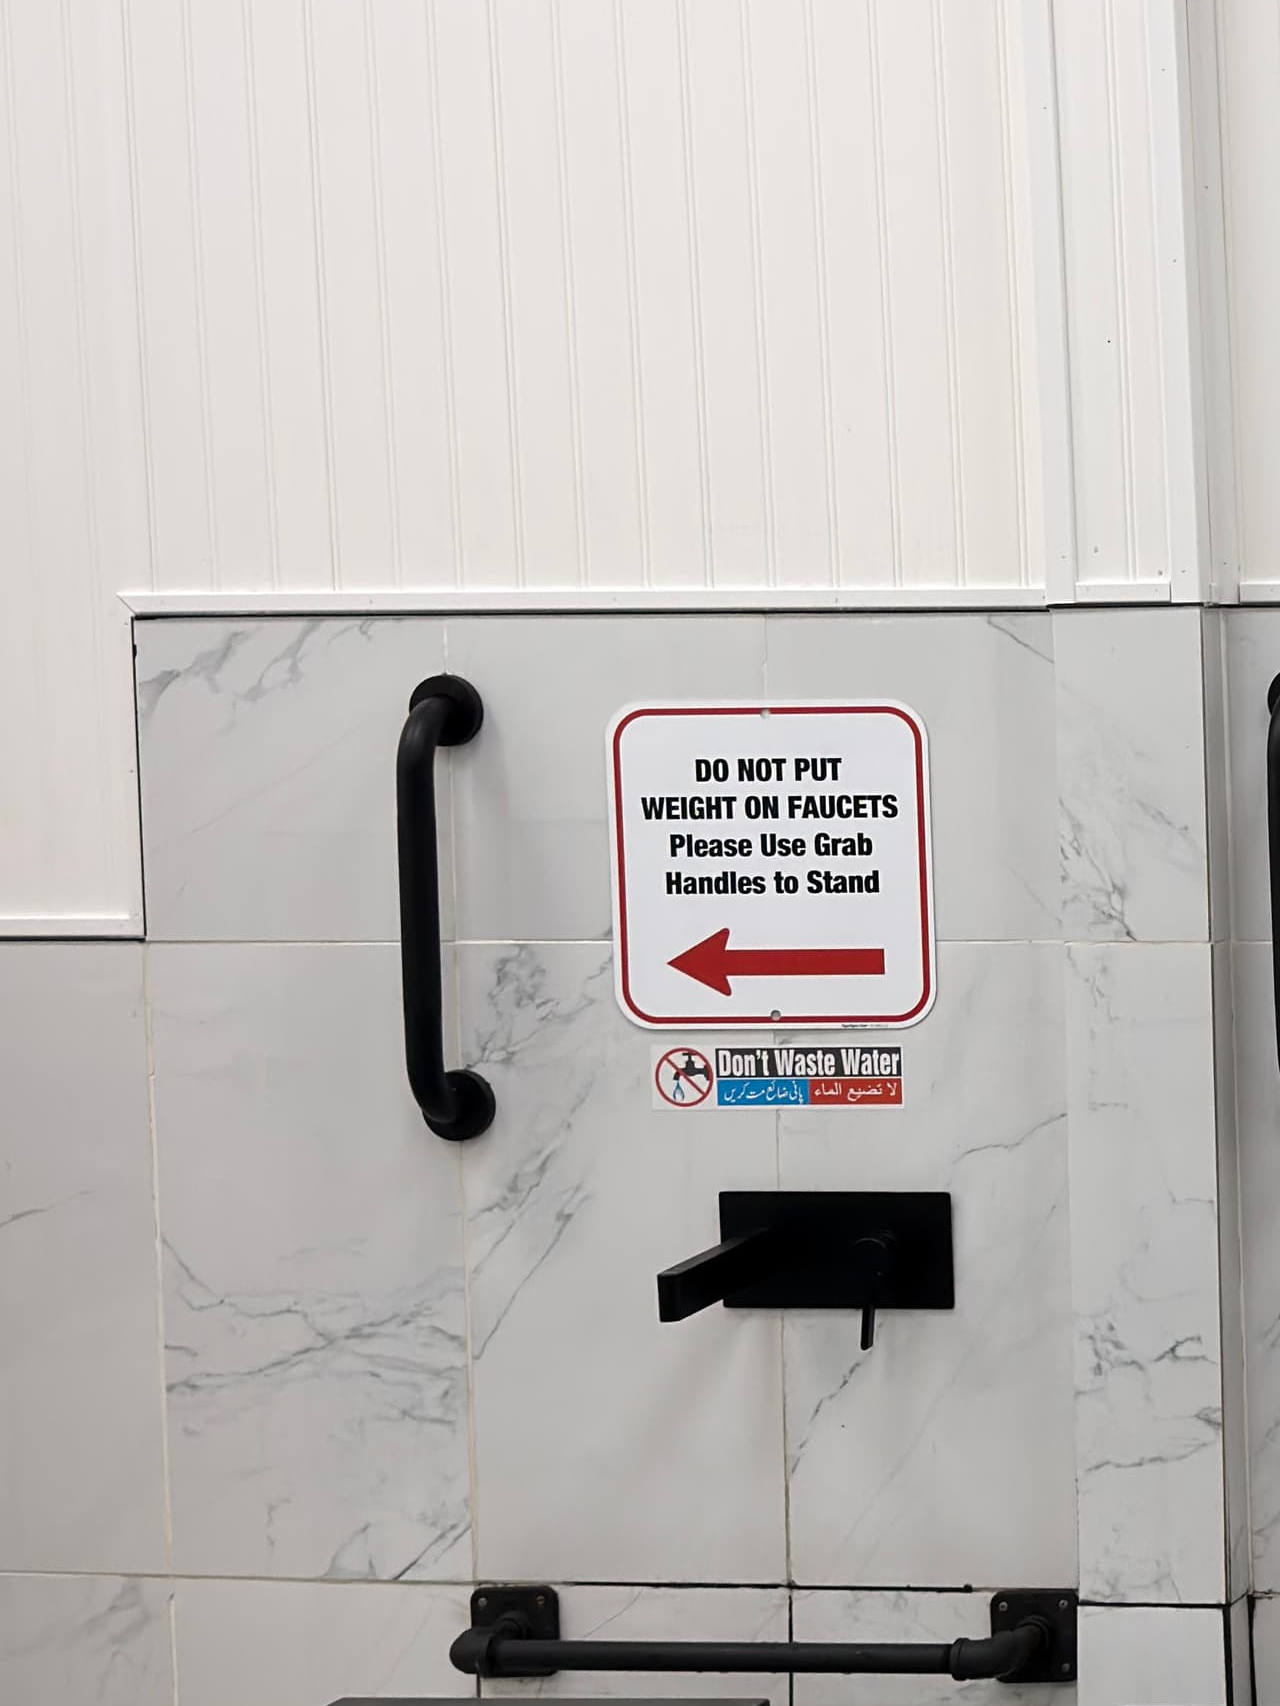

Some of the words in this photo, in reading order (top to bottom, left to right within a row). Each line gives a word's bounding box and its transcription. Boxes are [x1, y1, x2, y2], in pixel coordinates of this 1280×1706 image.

[695, 758, 729, 783] DO
[737, 757, 787, 782] NOT
[794, 757, 842, 782] PUT
[640, 796, 737, 820] WEIGHT
[744, 795, 780, 820] ON
[787, 794, 899, 819] FAUCETS
[669, 833, 753, 858] Please
[760, 833, 806, 857] Use
[814, 832, 873, 857] Grab
[665, 871, 767, 895] Handles
[773, 871, 799, 894] to
[806, 869, 880, 894] Stand
[774, 1049, 835, 1075] Waste
[840, 1048, 899, 1075] Water
